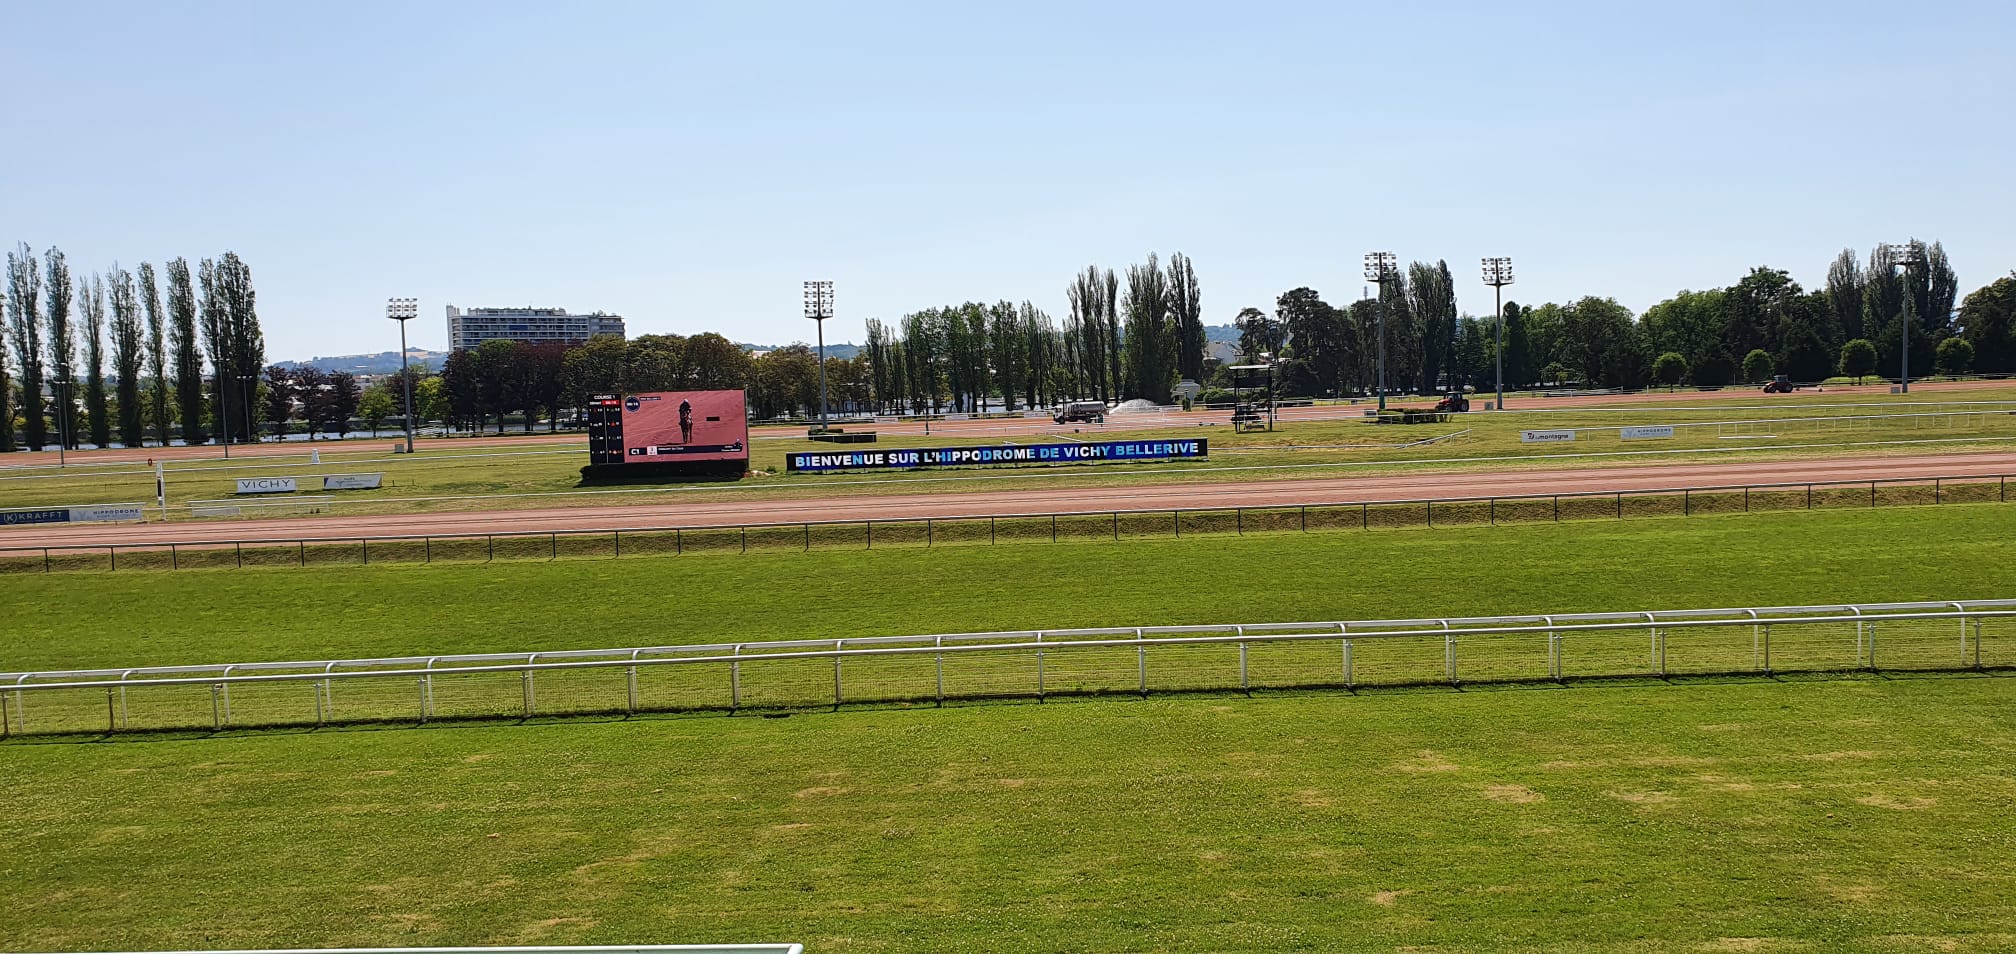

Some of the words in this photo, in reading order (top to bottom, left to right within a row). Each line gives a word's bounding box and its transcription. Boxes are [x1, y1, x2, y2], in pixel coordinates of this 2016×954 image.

[795, 453, 884, 467] BIENVENUE
[889, 452, 920, 464] SUR
[1039, 447, 1059, 459] DE
[1064, 445, 1111, 458] VICHY
[1115, 442, 1199, 456] BELLERIVE
[241, 479, 290, 489] VICHY
[18, 511, 62, 520] KRAFFT
